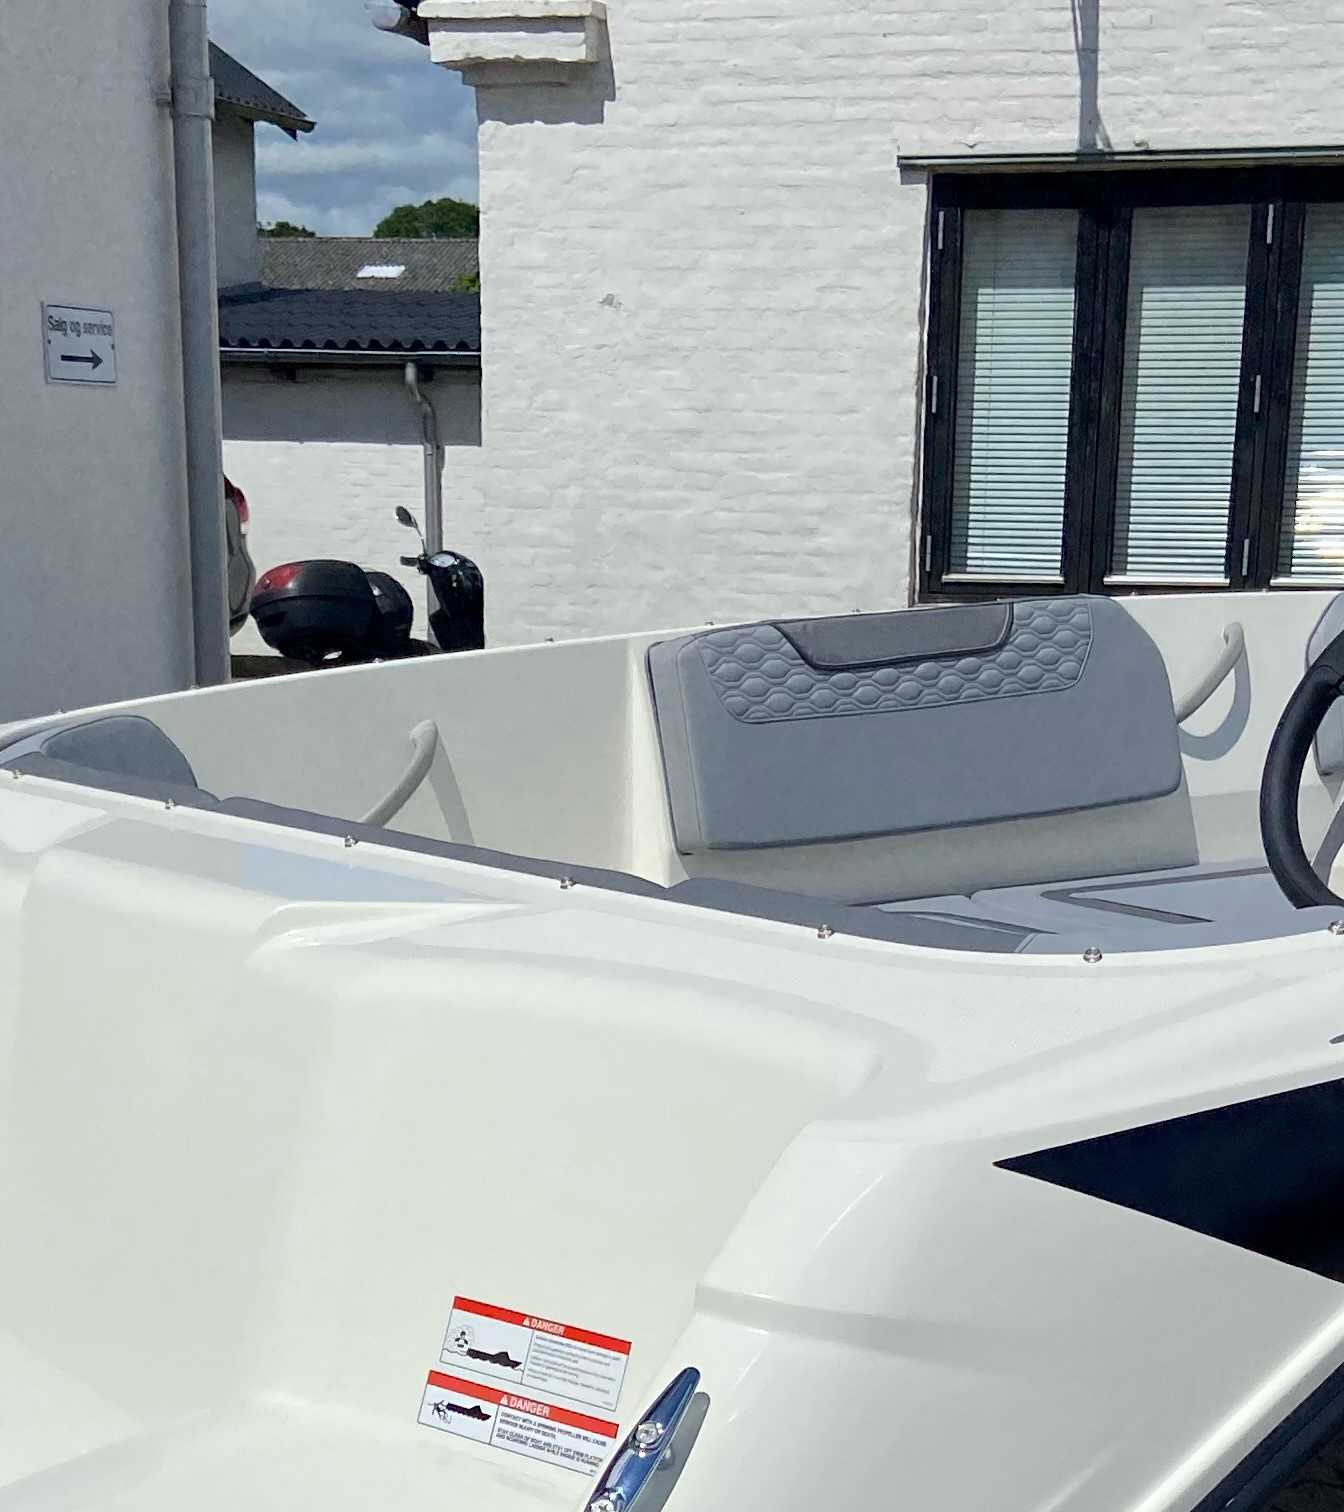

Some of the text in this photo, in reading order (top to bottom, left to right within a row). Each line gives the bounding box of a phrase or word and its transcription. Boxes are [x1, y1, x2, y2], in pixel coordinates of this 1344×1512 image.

[48, 315, 112, 337] Salg og service
[530, 1318, 565, 1336] DANGER
[510, 1397, 550, 1417] DANGER
